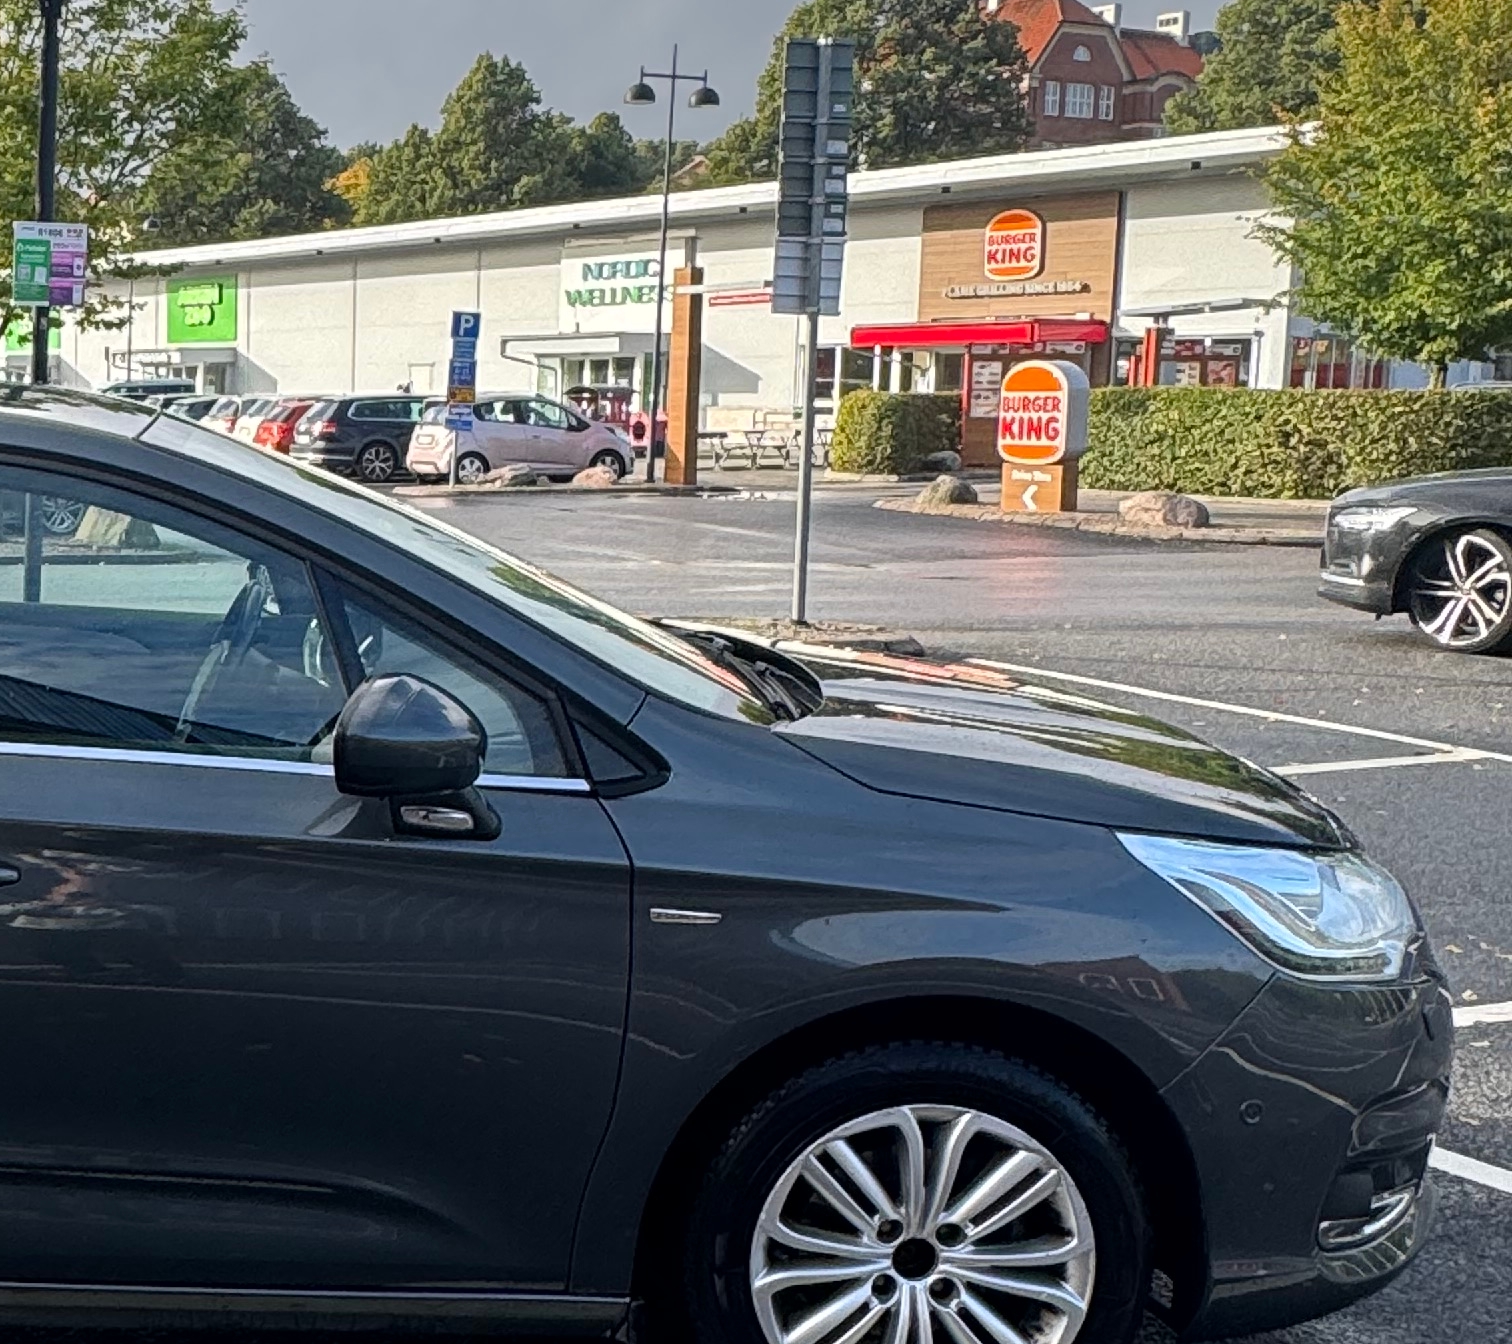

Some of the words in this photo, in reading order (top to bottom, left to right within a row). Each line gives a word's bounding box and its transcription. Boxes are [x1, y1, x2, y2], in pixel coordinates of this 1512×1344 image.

[987, 232, 1037, 246] BURGER
[986, 246, 1036, 265] KING
[582, 259, 660, 281] NORDIC
[565, 284, 674, 307] WELLNESS
[459, 314, 475, 337] P
[1002, 396, 1061, 413] BURGER
[1001, 416, 1060, 441] KING
